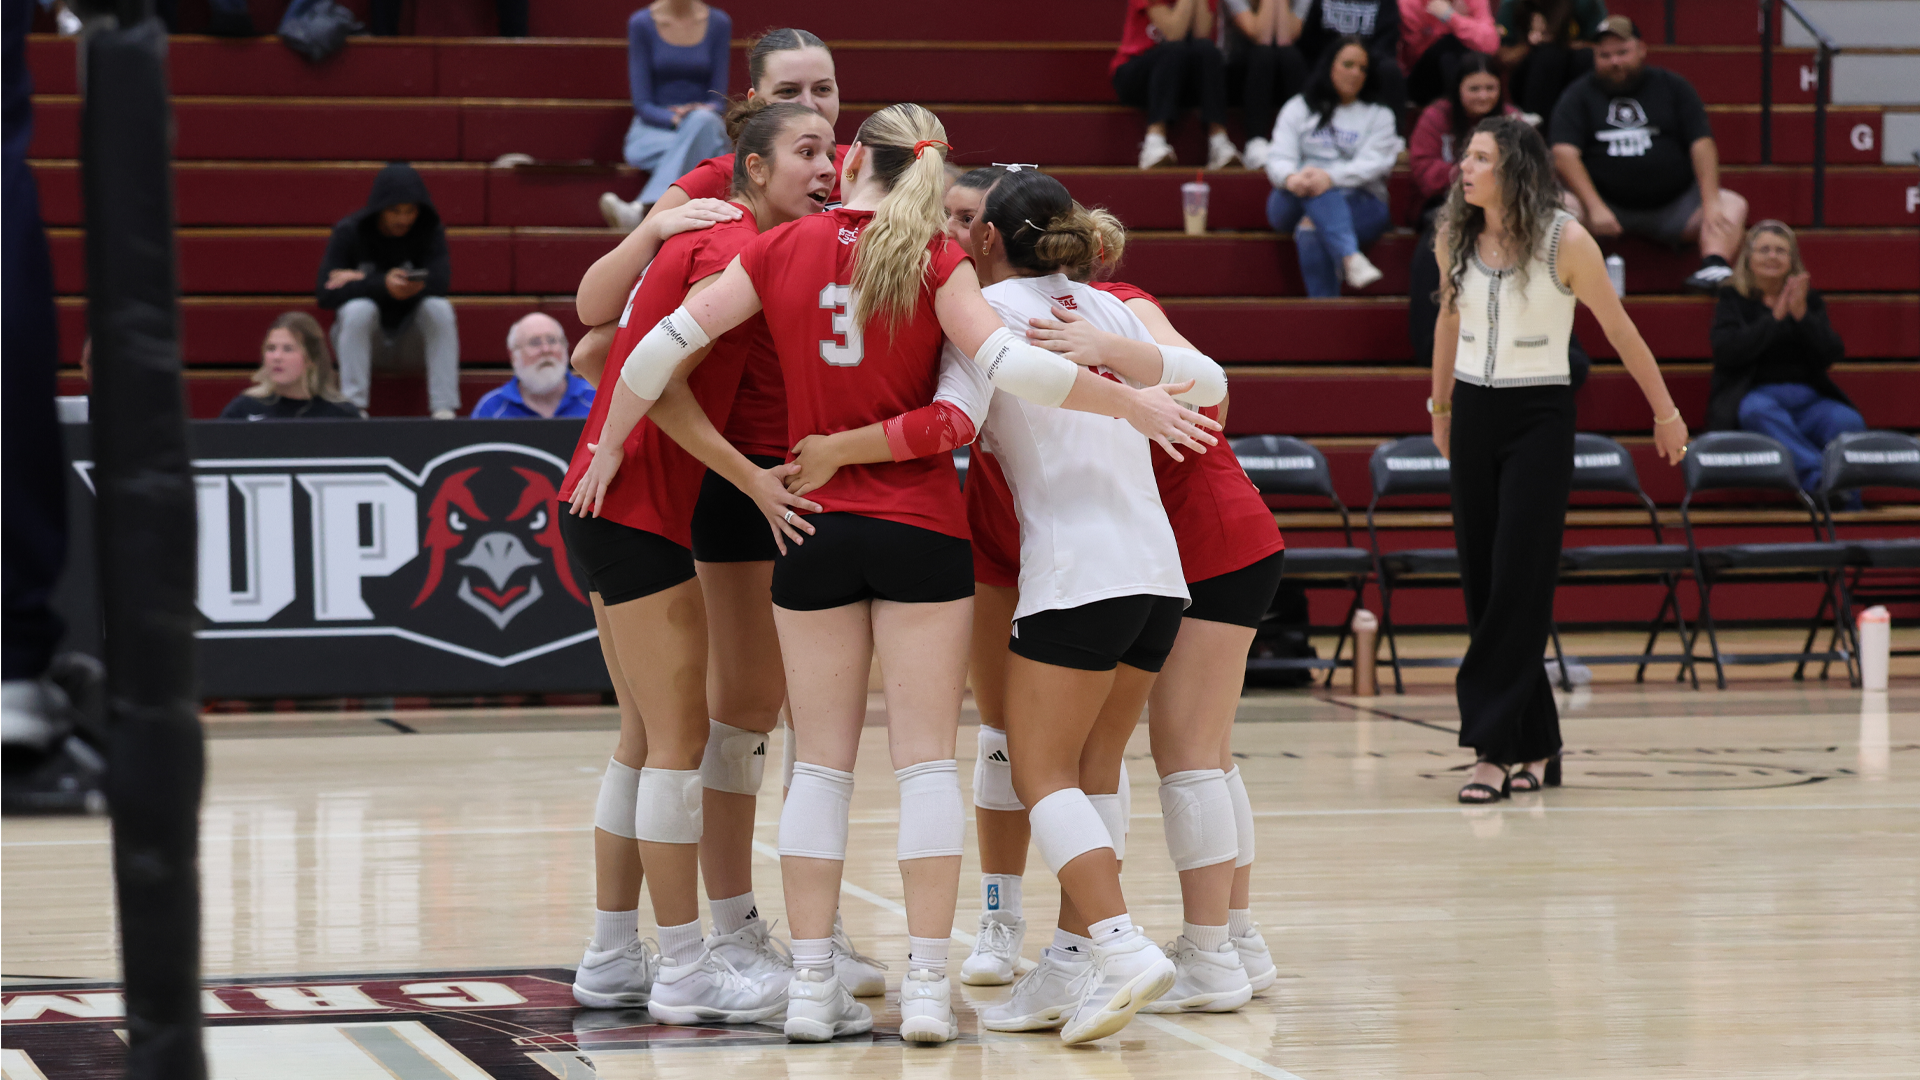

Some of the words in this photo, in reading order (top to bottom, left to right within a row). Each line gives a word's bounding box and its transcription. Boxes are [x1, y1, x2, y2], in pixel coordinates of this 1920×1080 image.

[1800, 65, 1819, 91] H
[1850, 123, 1874, 150] G
[819, 282, 865, 367] 3
[193, 474, 419, 623] UP
